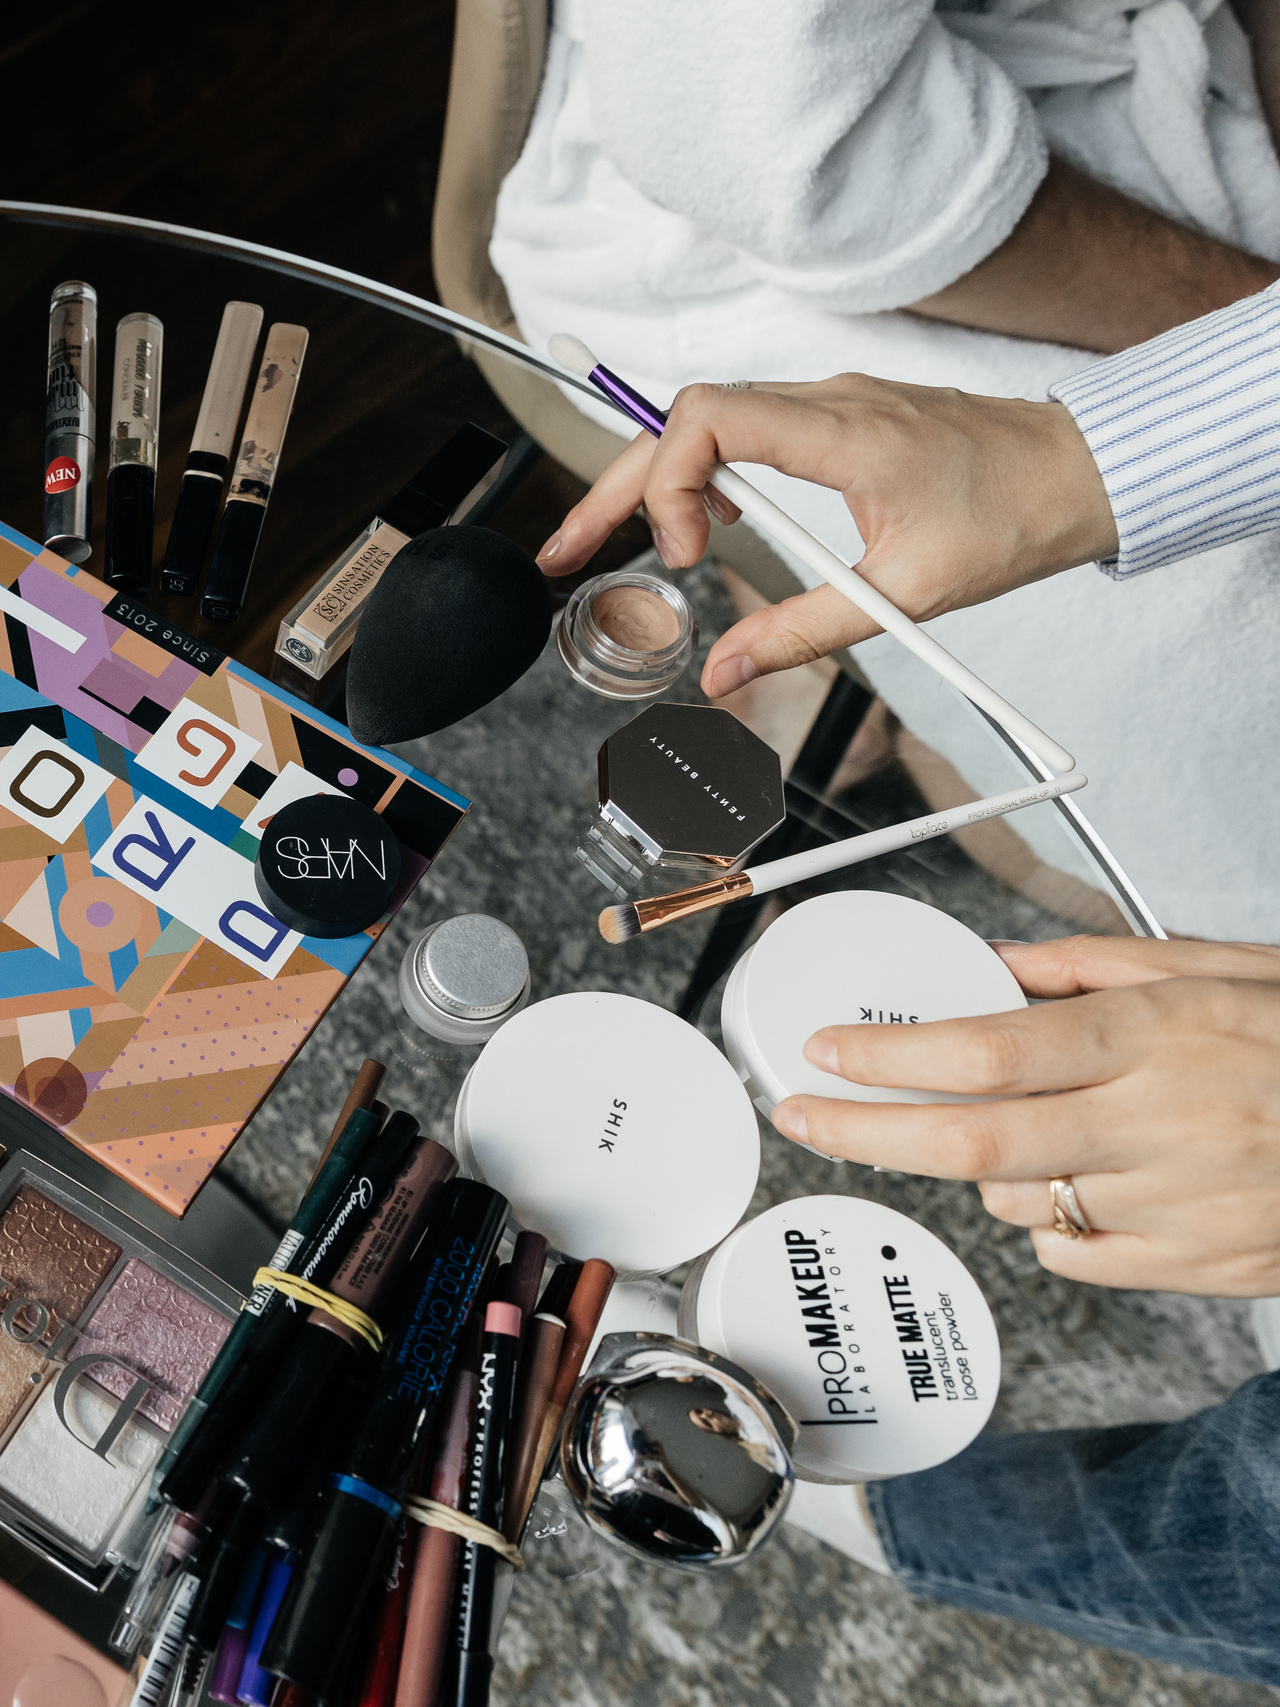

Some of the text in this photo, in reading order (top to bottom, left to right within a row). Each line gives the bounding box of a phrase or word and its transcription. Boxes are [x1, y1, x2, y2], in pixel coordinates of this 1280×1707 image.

[46, 464, 78, 487] NEW
[331, 543, 379, 595] SINSATION
[342, 548, 391, 601] COSMETICS
[114, 600, 213, 665] Since 2013
[648, 737, 699, 779] BEAUTY
[909, 819, 949, 842] topface
[968, 798, 1018, 820] PROFESSIONAL
[1019, 789, 1050, 807] MAKE-UP
[277, 834, 388, 882] NARS
[597, 1097, 628, 1154] SHIK
[395, 1257, 443, 1366] WATERPROOF VOLUME
[395, 1236, 476, 1403] 2000 CALORIE
[784, 1229, 858, 1416] PROMAKEUP
[820, 1227, 874, 1412] LABORATORY
[883, 1275, 938, 1401] TRUE MATTE
[923, 1311, 958, 1400] translucent
[937, 1291, 977, 1399] loose powder
[477, 1353, 496, 1410] NYX
